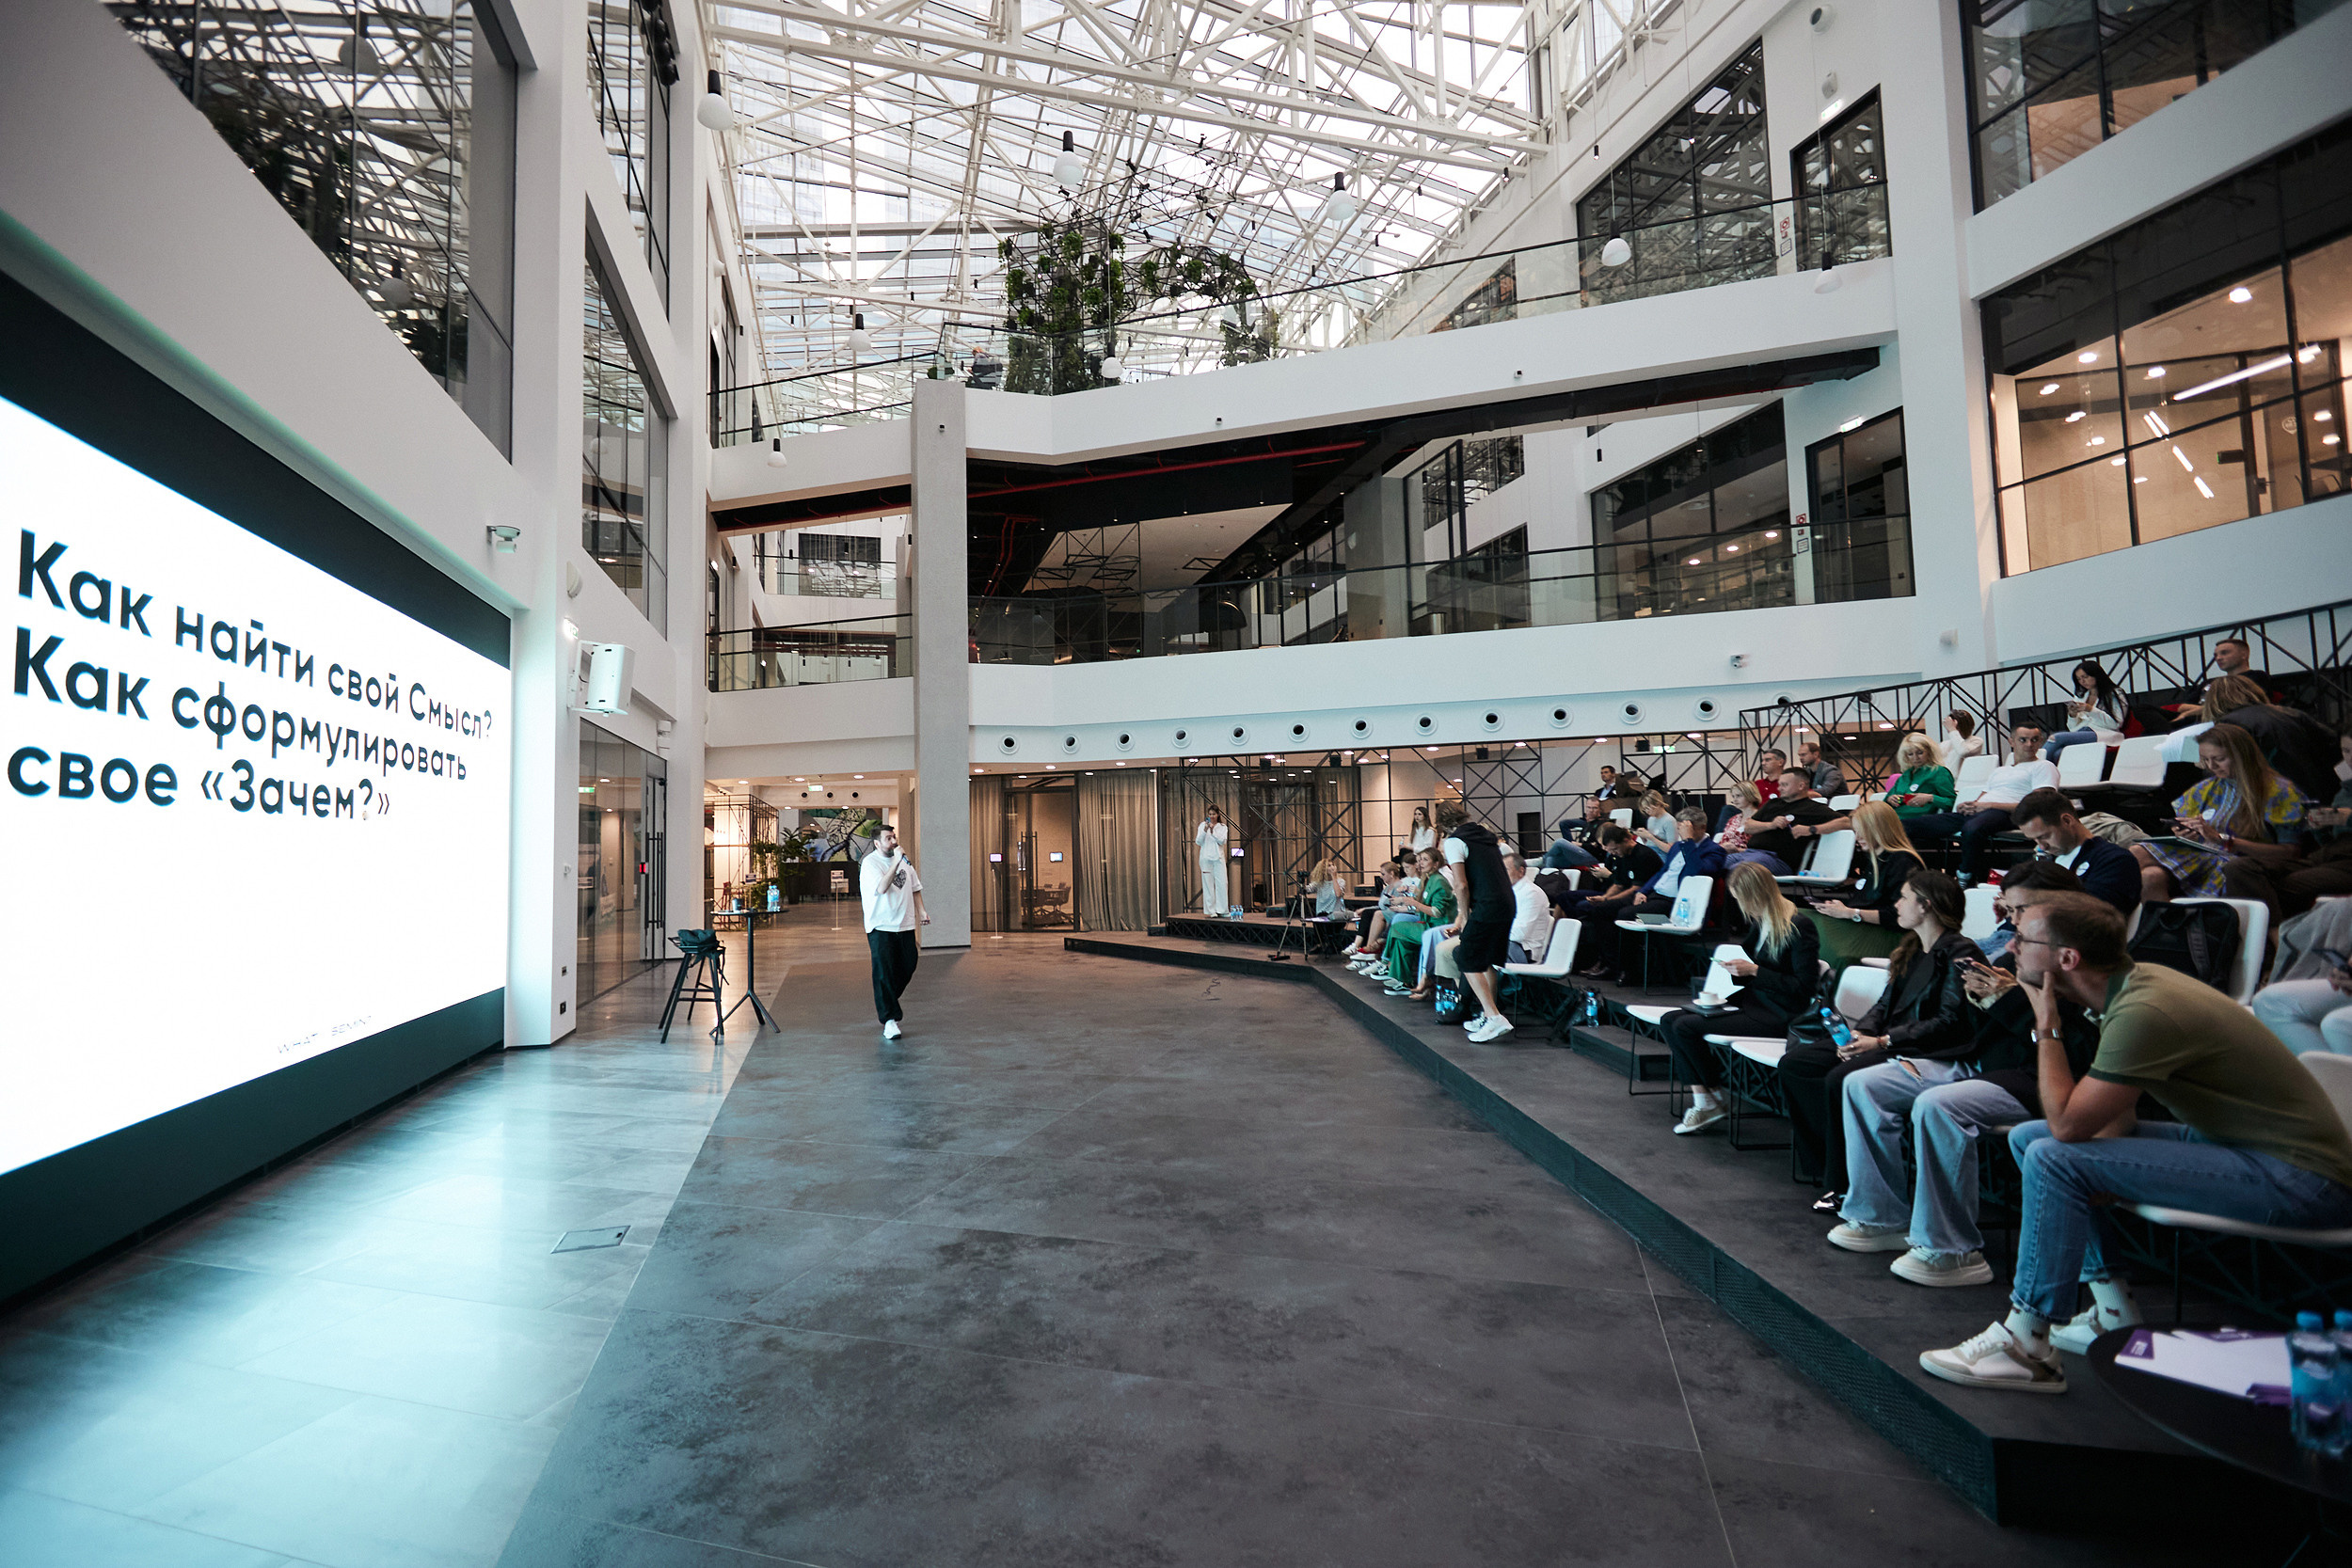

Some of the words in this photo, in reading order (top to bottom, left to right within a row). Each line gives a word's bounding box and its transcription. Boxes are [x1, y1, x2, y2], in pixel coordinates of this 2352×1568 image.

[13, 626, 151, 721] Как
[171, 680, 467, 781] сформулировать
[19, 528, 154, 638] Как
[175, 605, 314, 688] найти
[327, 663, 399, 714] свой
[409, 682, 492, 739] Смысл?
[7, 746, 179, 807] свое
[200, 758, 390, 821] «Зачем?»
